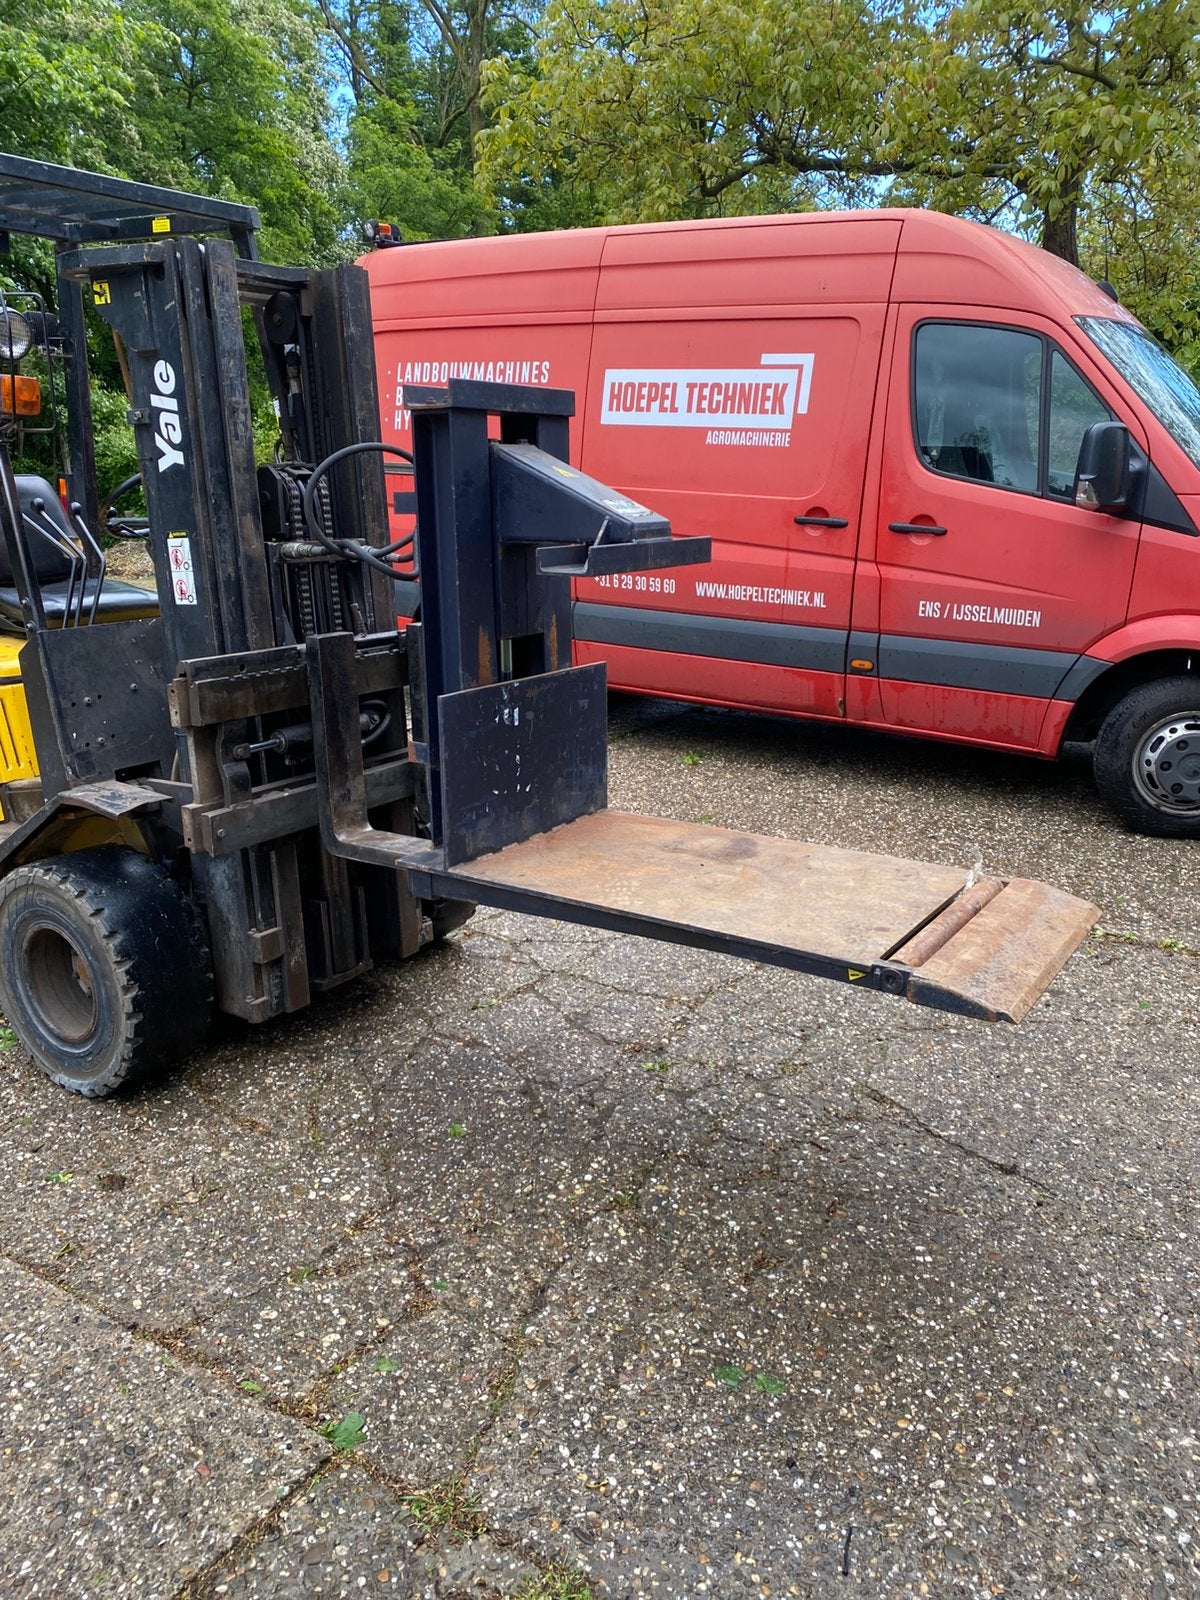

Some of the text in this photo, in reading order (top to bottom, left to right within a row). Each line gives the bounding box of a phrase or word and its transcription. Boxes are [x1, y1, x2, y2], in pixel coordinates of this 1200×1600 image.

[397, 361, 550, 383] LANDBOUWMACHINES
[608, 382, 789, 415] HOEPEL TECHNIEK
[150, 359, 185, 473] Yale
[706, 430, 791, 447] AGROMACHINERIE
[613, 574, 619, 588] 6
[621, 575, 633, 589] 29
[635, 576, 647, 591] 30
[649, 577, 661, 592] 59
[663, 578, 676, 594] 60
[695, 581, 827, 608] WWW.HOEPELTECHNIEK.NL
[918, 600, 1041, 628] ENS / IJSSELMUIDEN
